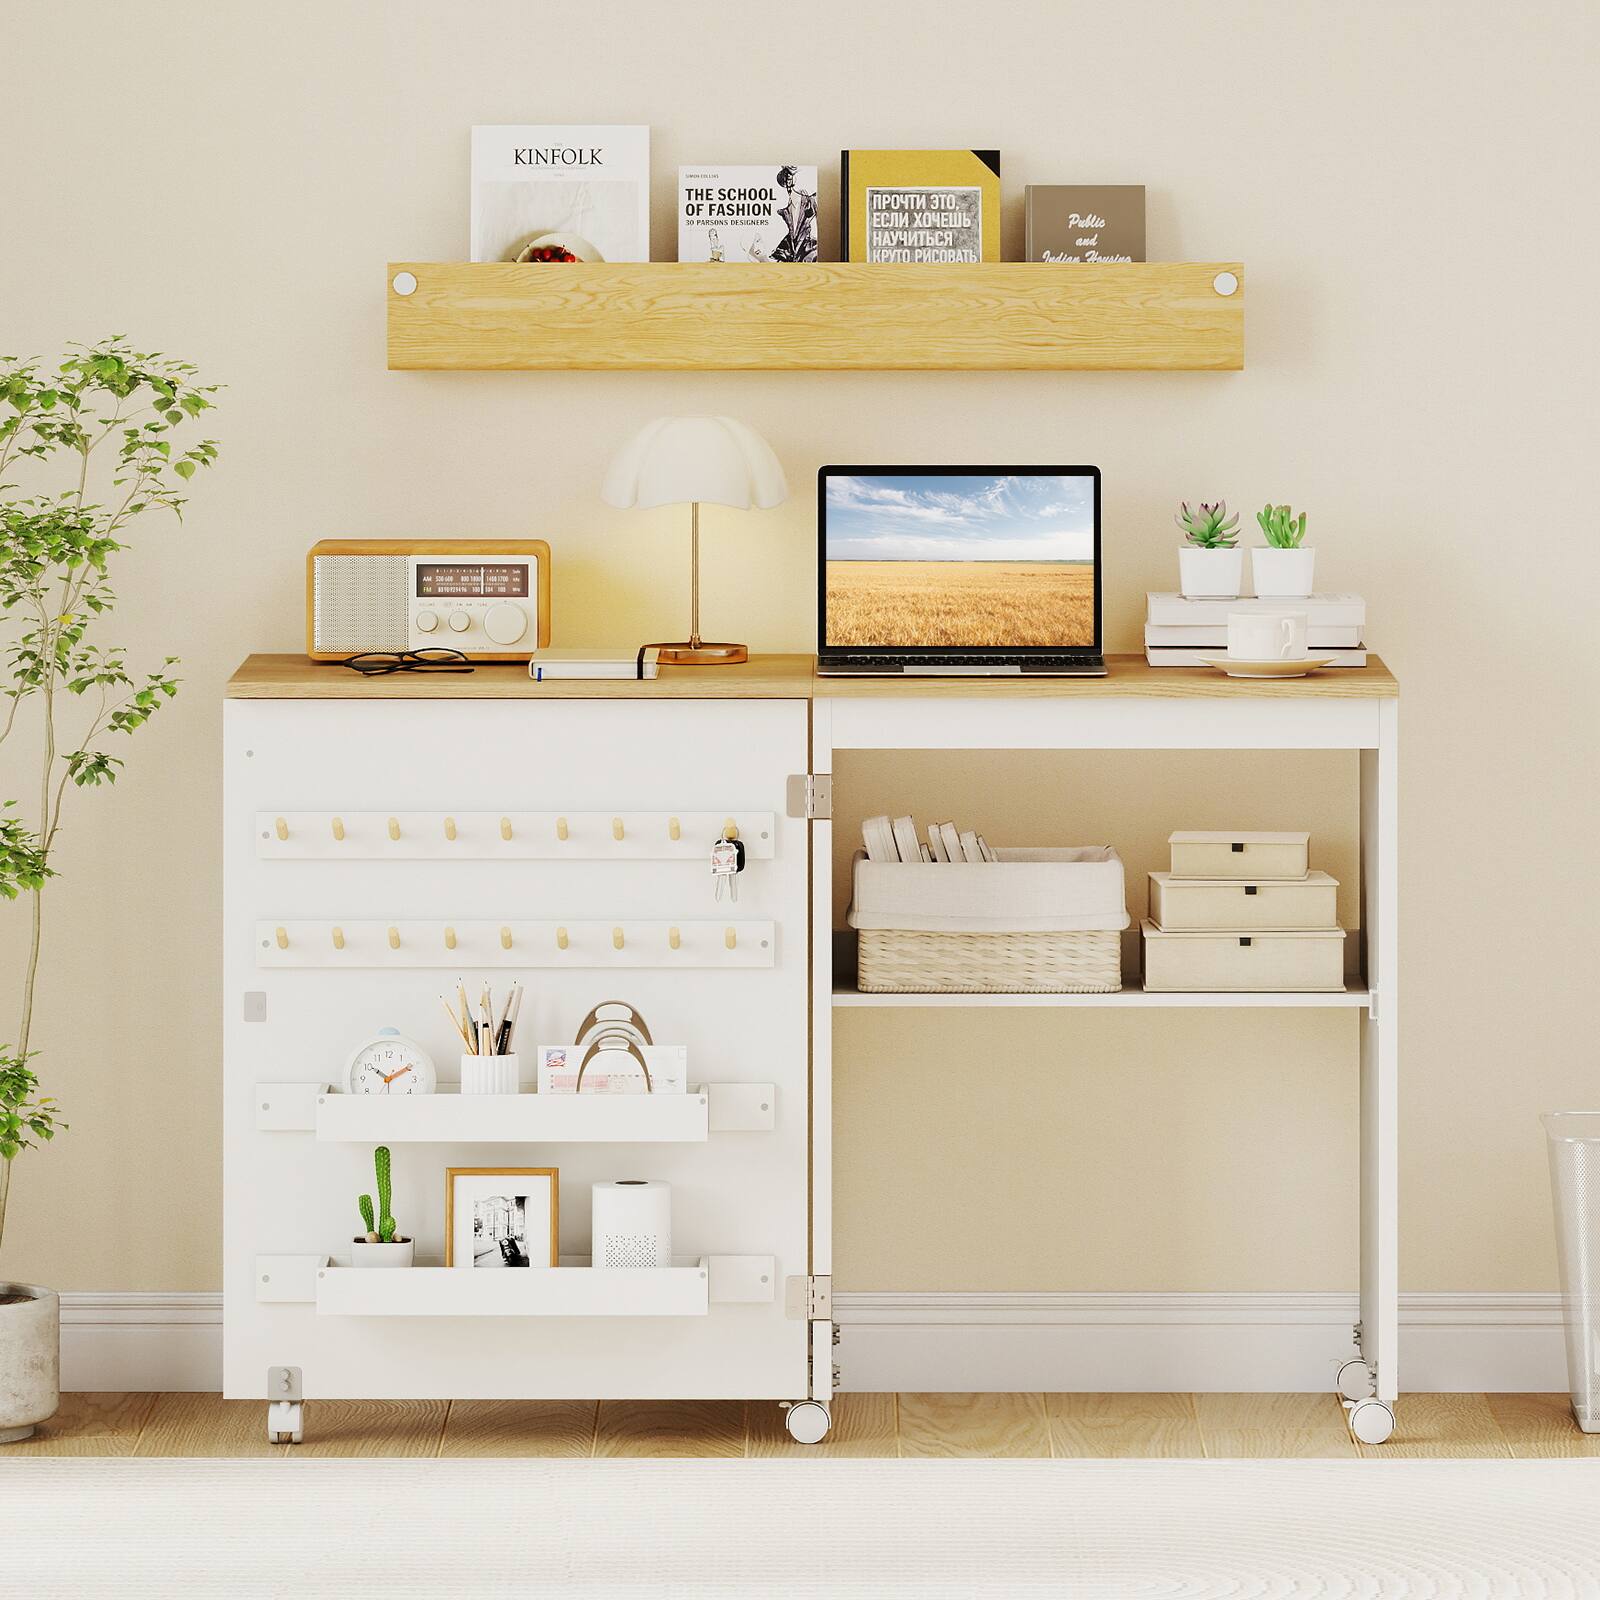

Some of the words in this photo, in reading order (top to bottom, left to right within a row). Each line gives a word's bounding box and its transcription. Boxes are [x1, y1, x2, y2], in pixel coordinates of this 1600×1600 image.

[513, 148, 603, 165] KINFOLK
[685, 188, 714, 201] THE
[717, 187, 777, 201] SCHOOL
[872, 194, 926, 210] ПРОЧТИ
[930, 194, 960, 211] ЭТО,
[685, 203, 704, 216] OF
[708, 203, 772, 216] FASHION
[872, 212, 909, 228] ЕСЛИ
[912, 212, 972, 228] ХОЧЕШЬ
[1068, 213, 1106, 229] Public
[872, 230, 953, 247] НАУЧИТЬСЯ
[1075, 233, 1098, 246] and
[872, 249, 911, 263] КРУТО
[914, 248, 978, 263] РИСОВАТЬ
[1042, 250, 1081, 263] Indian
[385, 1050, 394, 1058] 12
[364, 1063, 373, 1071] 10
[360, 1075, 366, 1083] 9
[412, 1075, 417, 1083] 3
